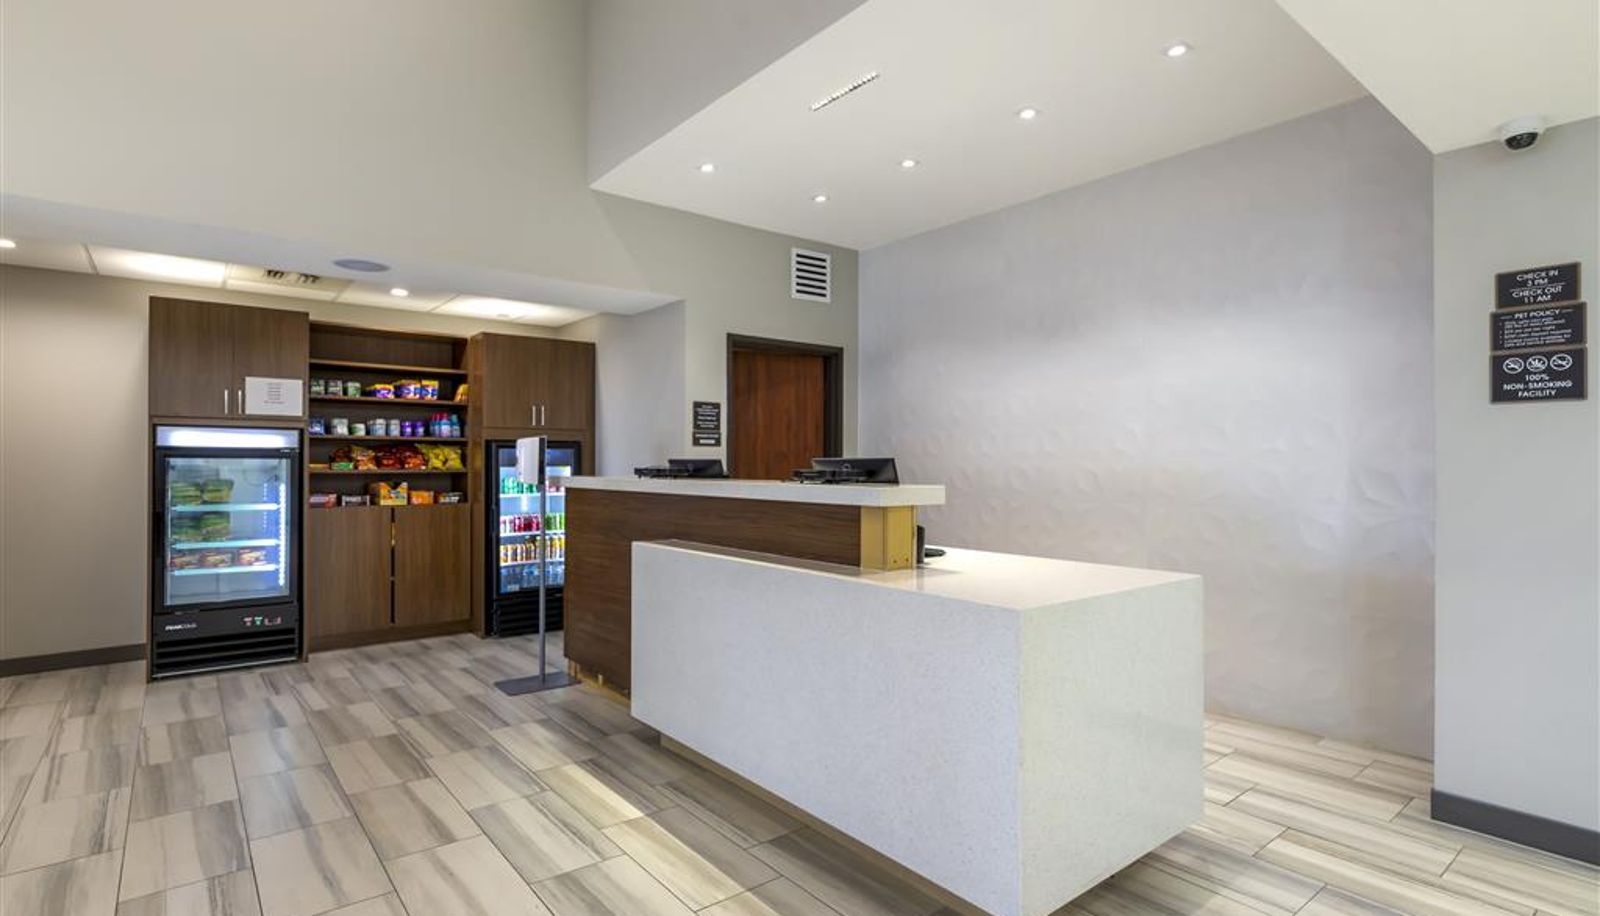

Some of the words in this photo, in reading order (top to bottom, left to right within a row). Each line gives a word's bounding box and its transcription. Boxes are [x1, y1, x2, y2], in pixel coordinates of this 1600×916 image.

[1516, 271, 1547, 282] CHECK
[1548, 269, 1559, 277] IN
[1534, 278, 1549, 286] PM
[1511, 288, 1543, 298] CHECK
[1544, 285, 1562, 294] OUT
[1514, 312, 1528, 320] PET
[1529, 308, 1560, 318] POLICY
[1525, 373, 1550, 381] 100%
[1503, 380, 1573, 391] NON-SMOKING
[1518, 389, 1557, 398] FACILITY
